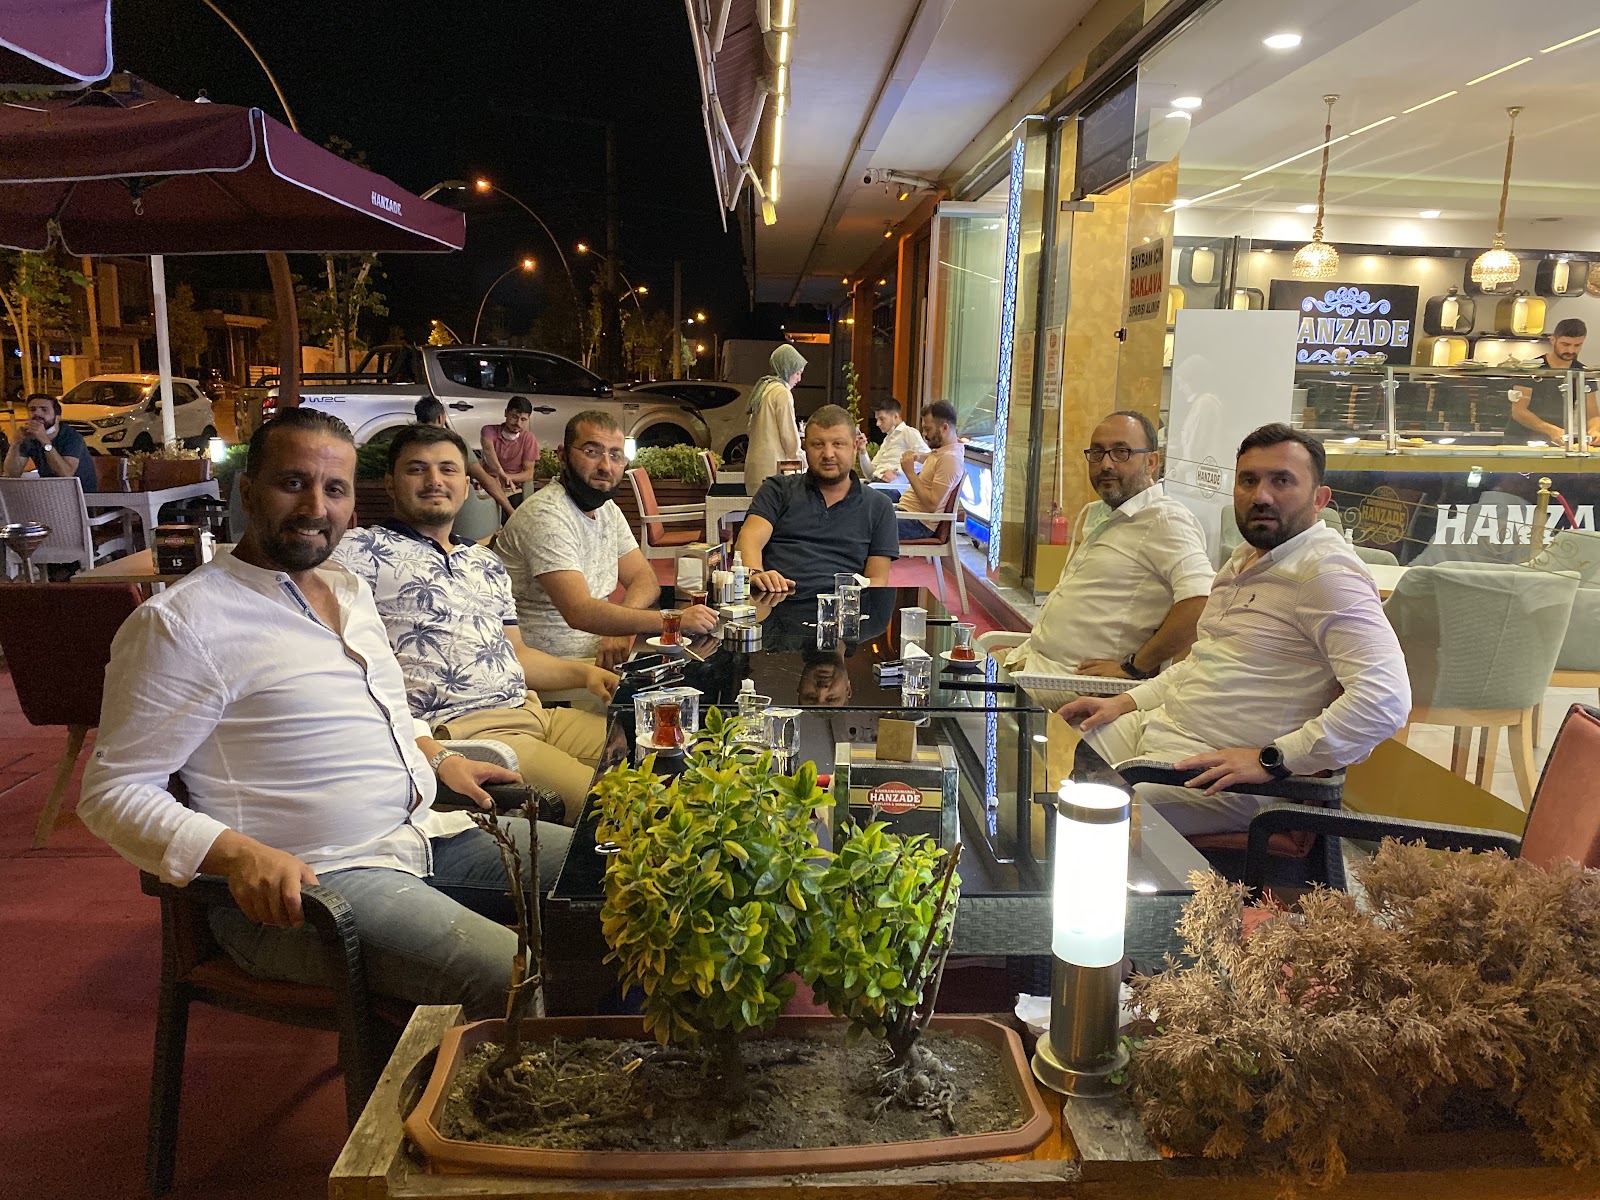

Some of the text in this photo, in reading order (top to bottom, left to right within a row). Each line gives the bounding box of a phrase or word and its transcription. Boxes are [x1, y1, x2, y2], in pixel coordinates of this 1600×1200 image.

[371, 190, 402, 216] HANZADE
[1131, 250, 1153, 271] BAYRAM
[1130, 271, 1162, 299] BAKLAVA
[1297, 317, 1409, 347] ANZADE
[1197, 470, 1220, 485] HANZADE
[1361, 504, 1406, 527] HANZADE
[172, 558, 183, 567] 15
[870, 793, 921, 803] HANZADE
